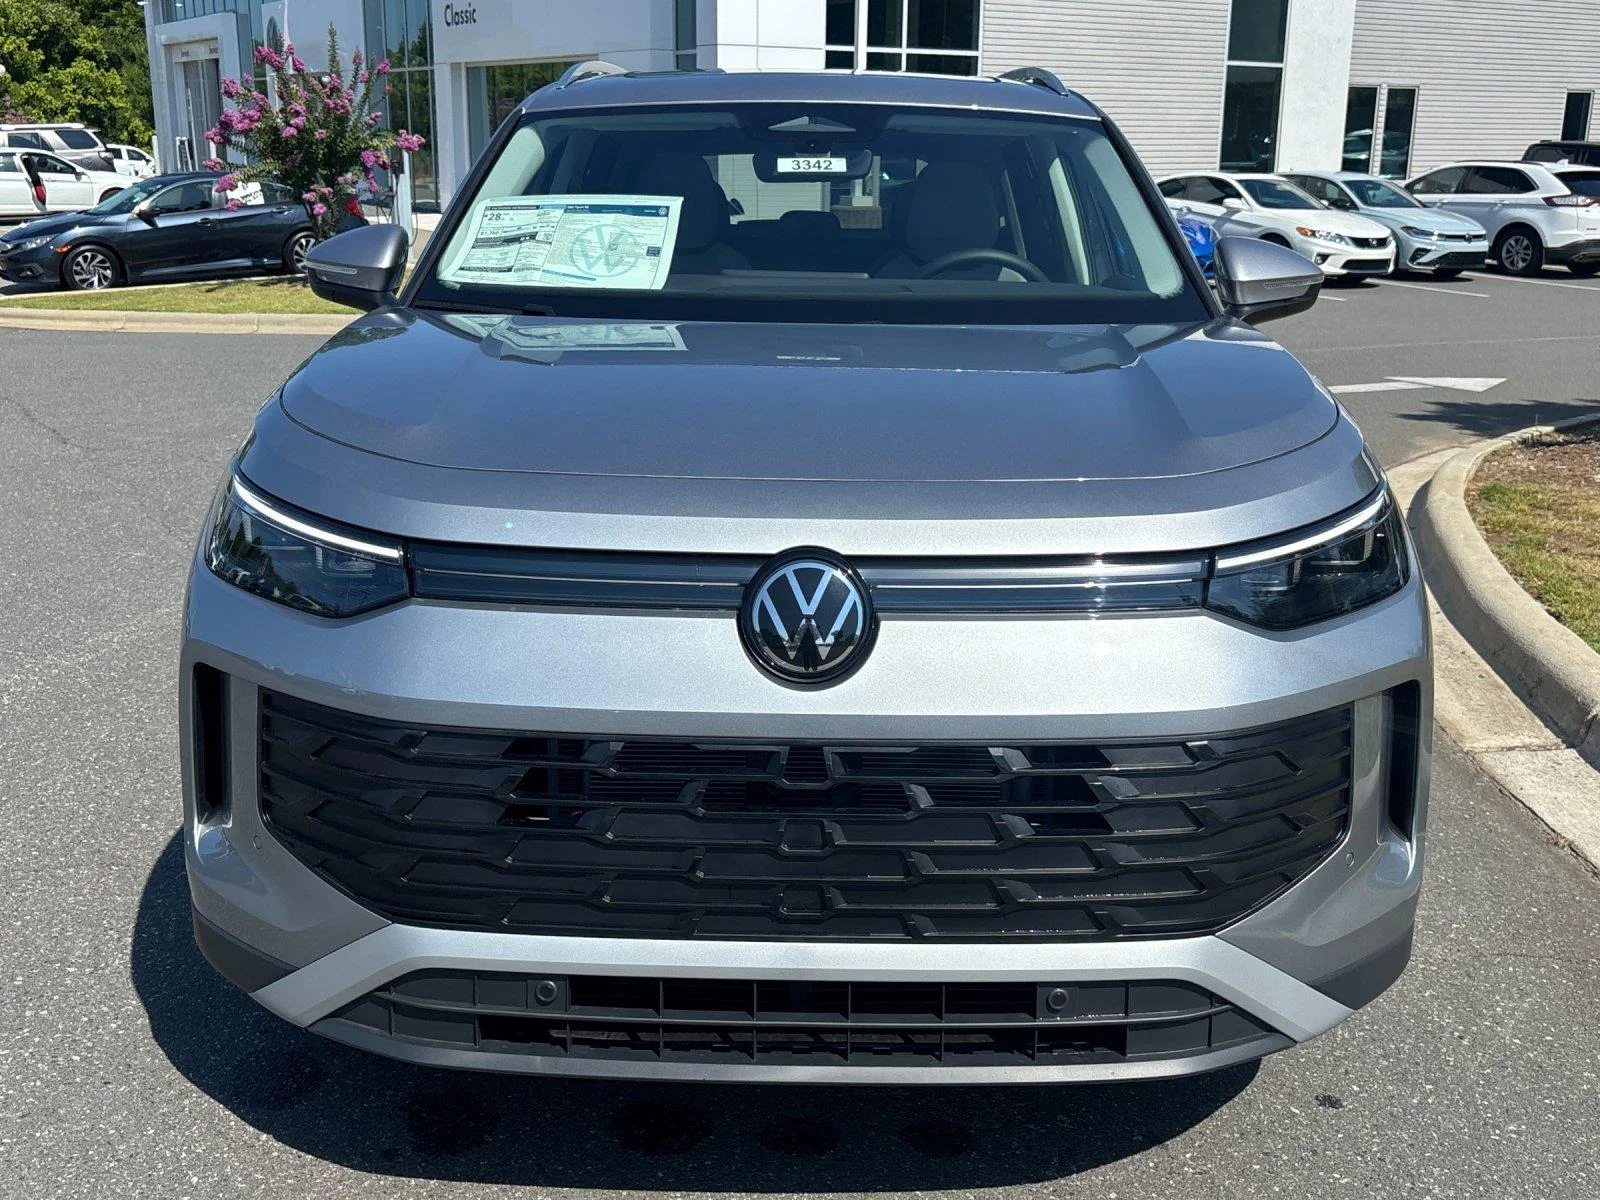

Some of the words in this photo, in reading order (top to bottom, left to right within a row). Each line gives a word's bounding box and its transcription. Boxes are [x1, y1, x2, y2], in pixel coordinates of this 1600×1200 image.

[444, 2, 477, 27] Classic
[791, 159, 833, 170] 3342
[488, 213, 502, 221] 28
[756, 564, 860, 664] VW
